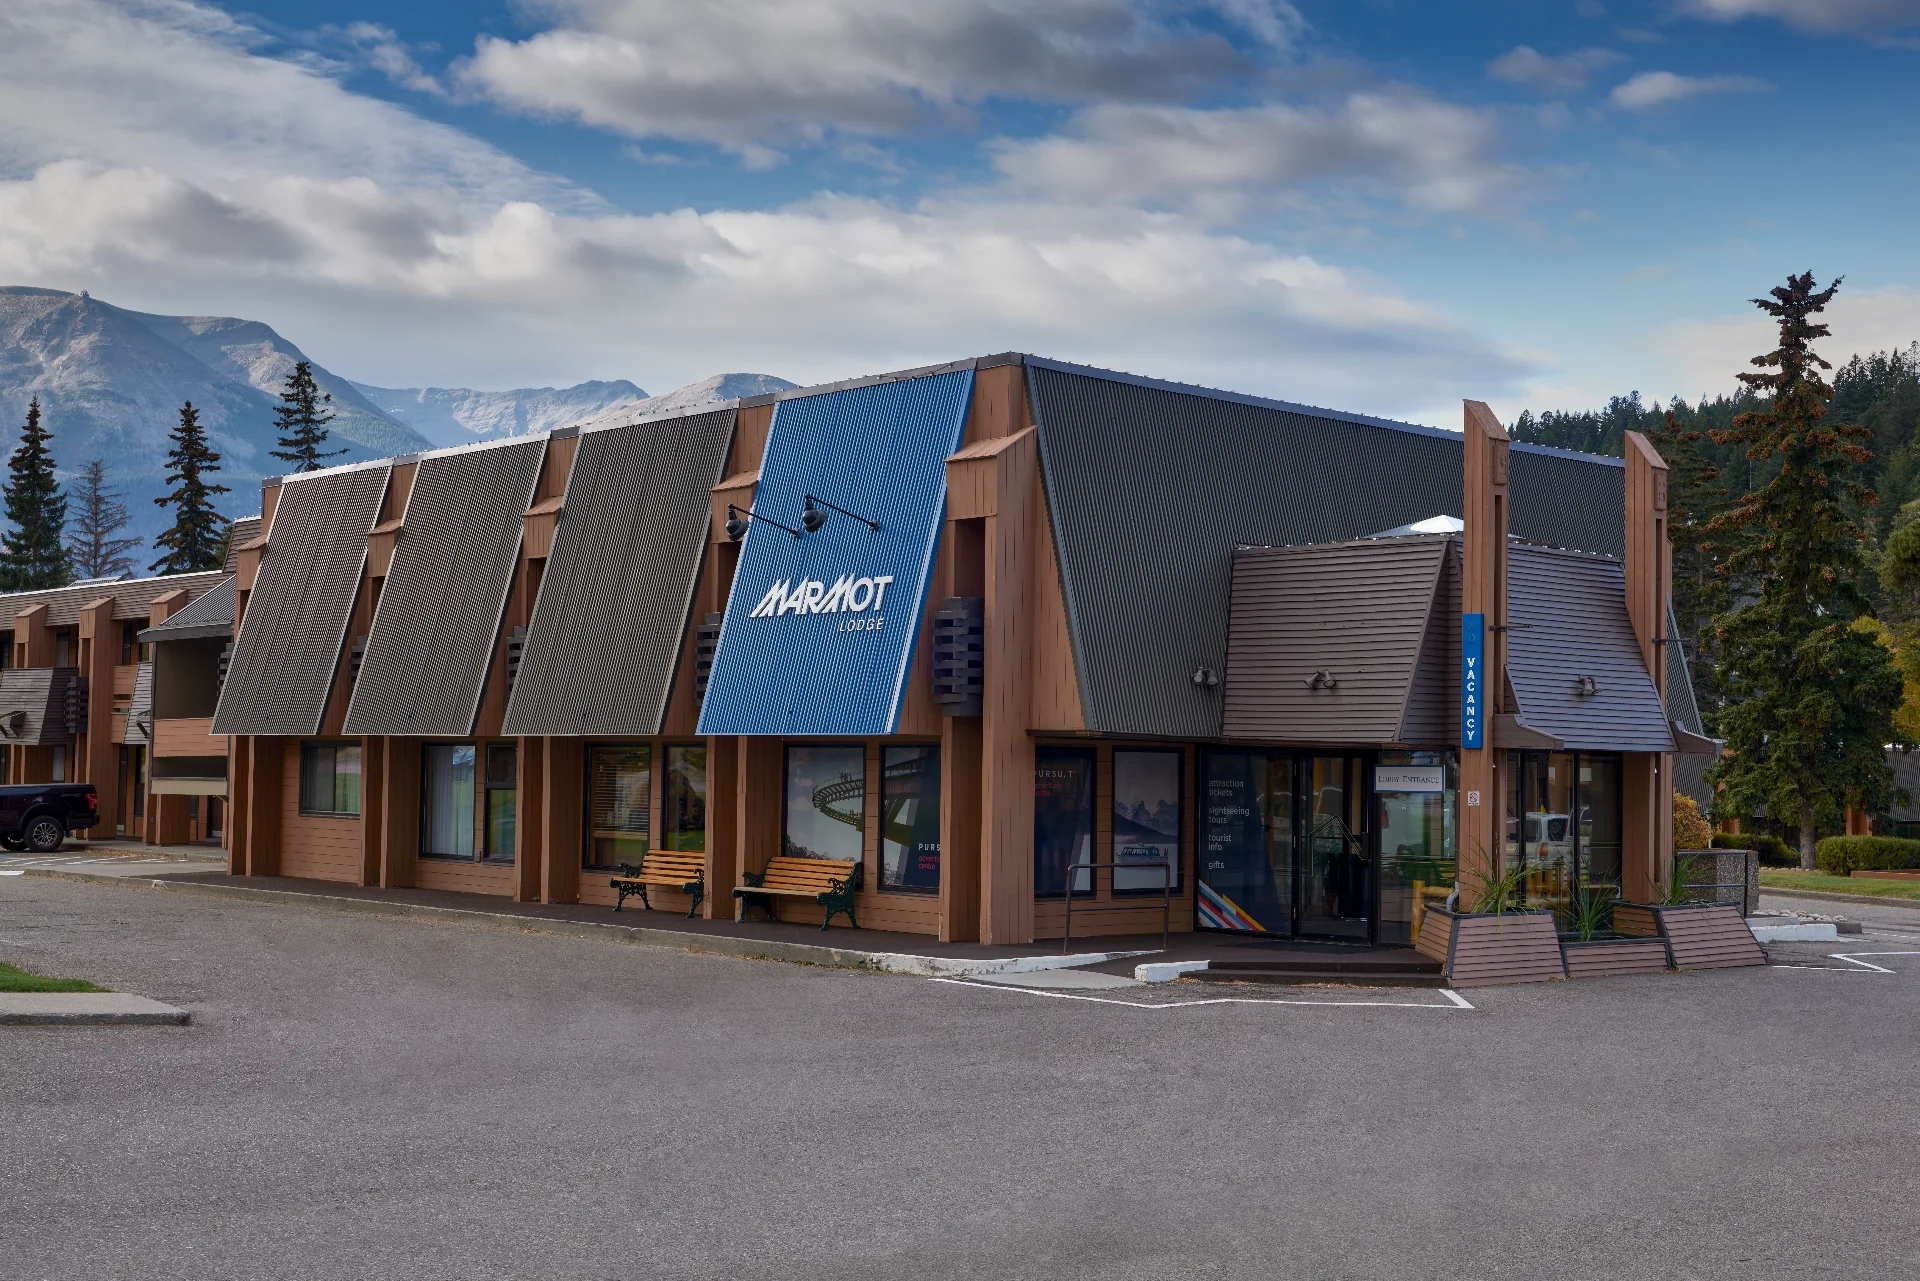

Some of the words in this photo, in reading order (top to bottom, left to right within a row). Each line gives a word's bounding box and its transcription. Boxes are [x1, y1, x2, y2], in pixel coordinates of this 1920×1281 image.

[750, 573, 893, 618] MARMOT
[839, 618, 884, 632] LODGE
[1466, 657, 1476, 740] VACANCY
[1208, 779, 1244, 788] attraction
[1378, 775, 1399, 783] LOBBY
[1402, 775, 1440, 784] ENTRANCE
[1208, 788, 1233, 797] tickets
[1208, 806, 1250, 817] sightseeing
[1208, 816, 1228, 824] tours
[1208, 833, 1232, 842] tourist
[1208, 842, 1223, 851] info
[1208, 860, 1225, 870] gifts
